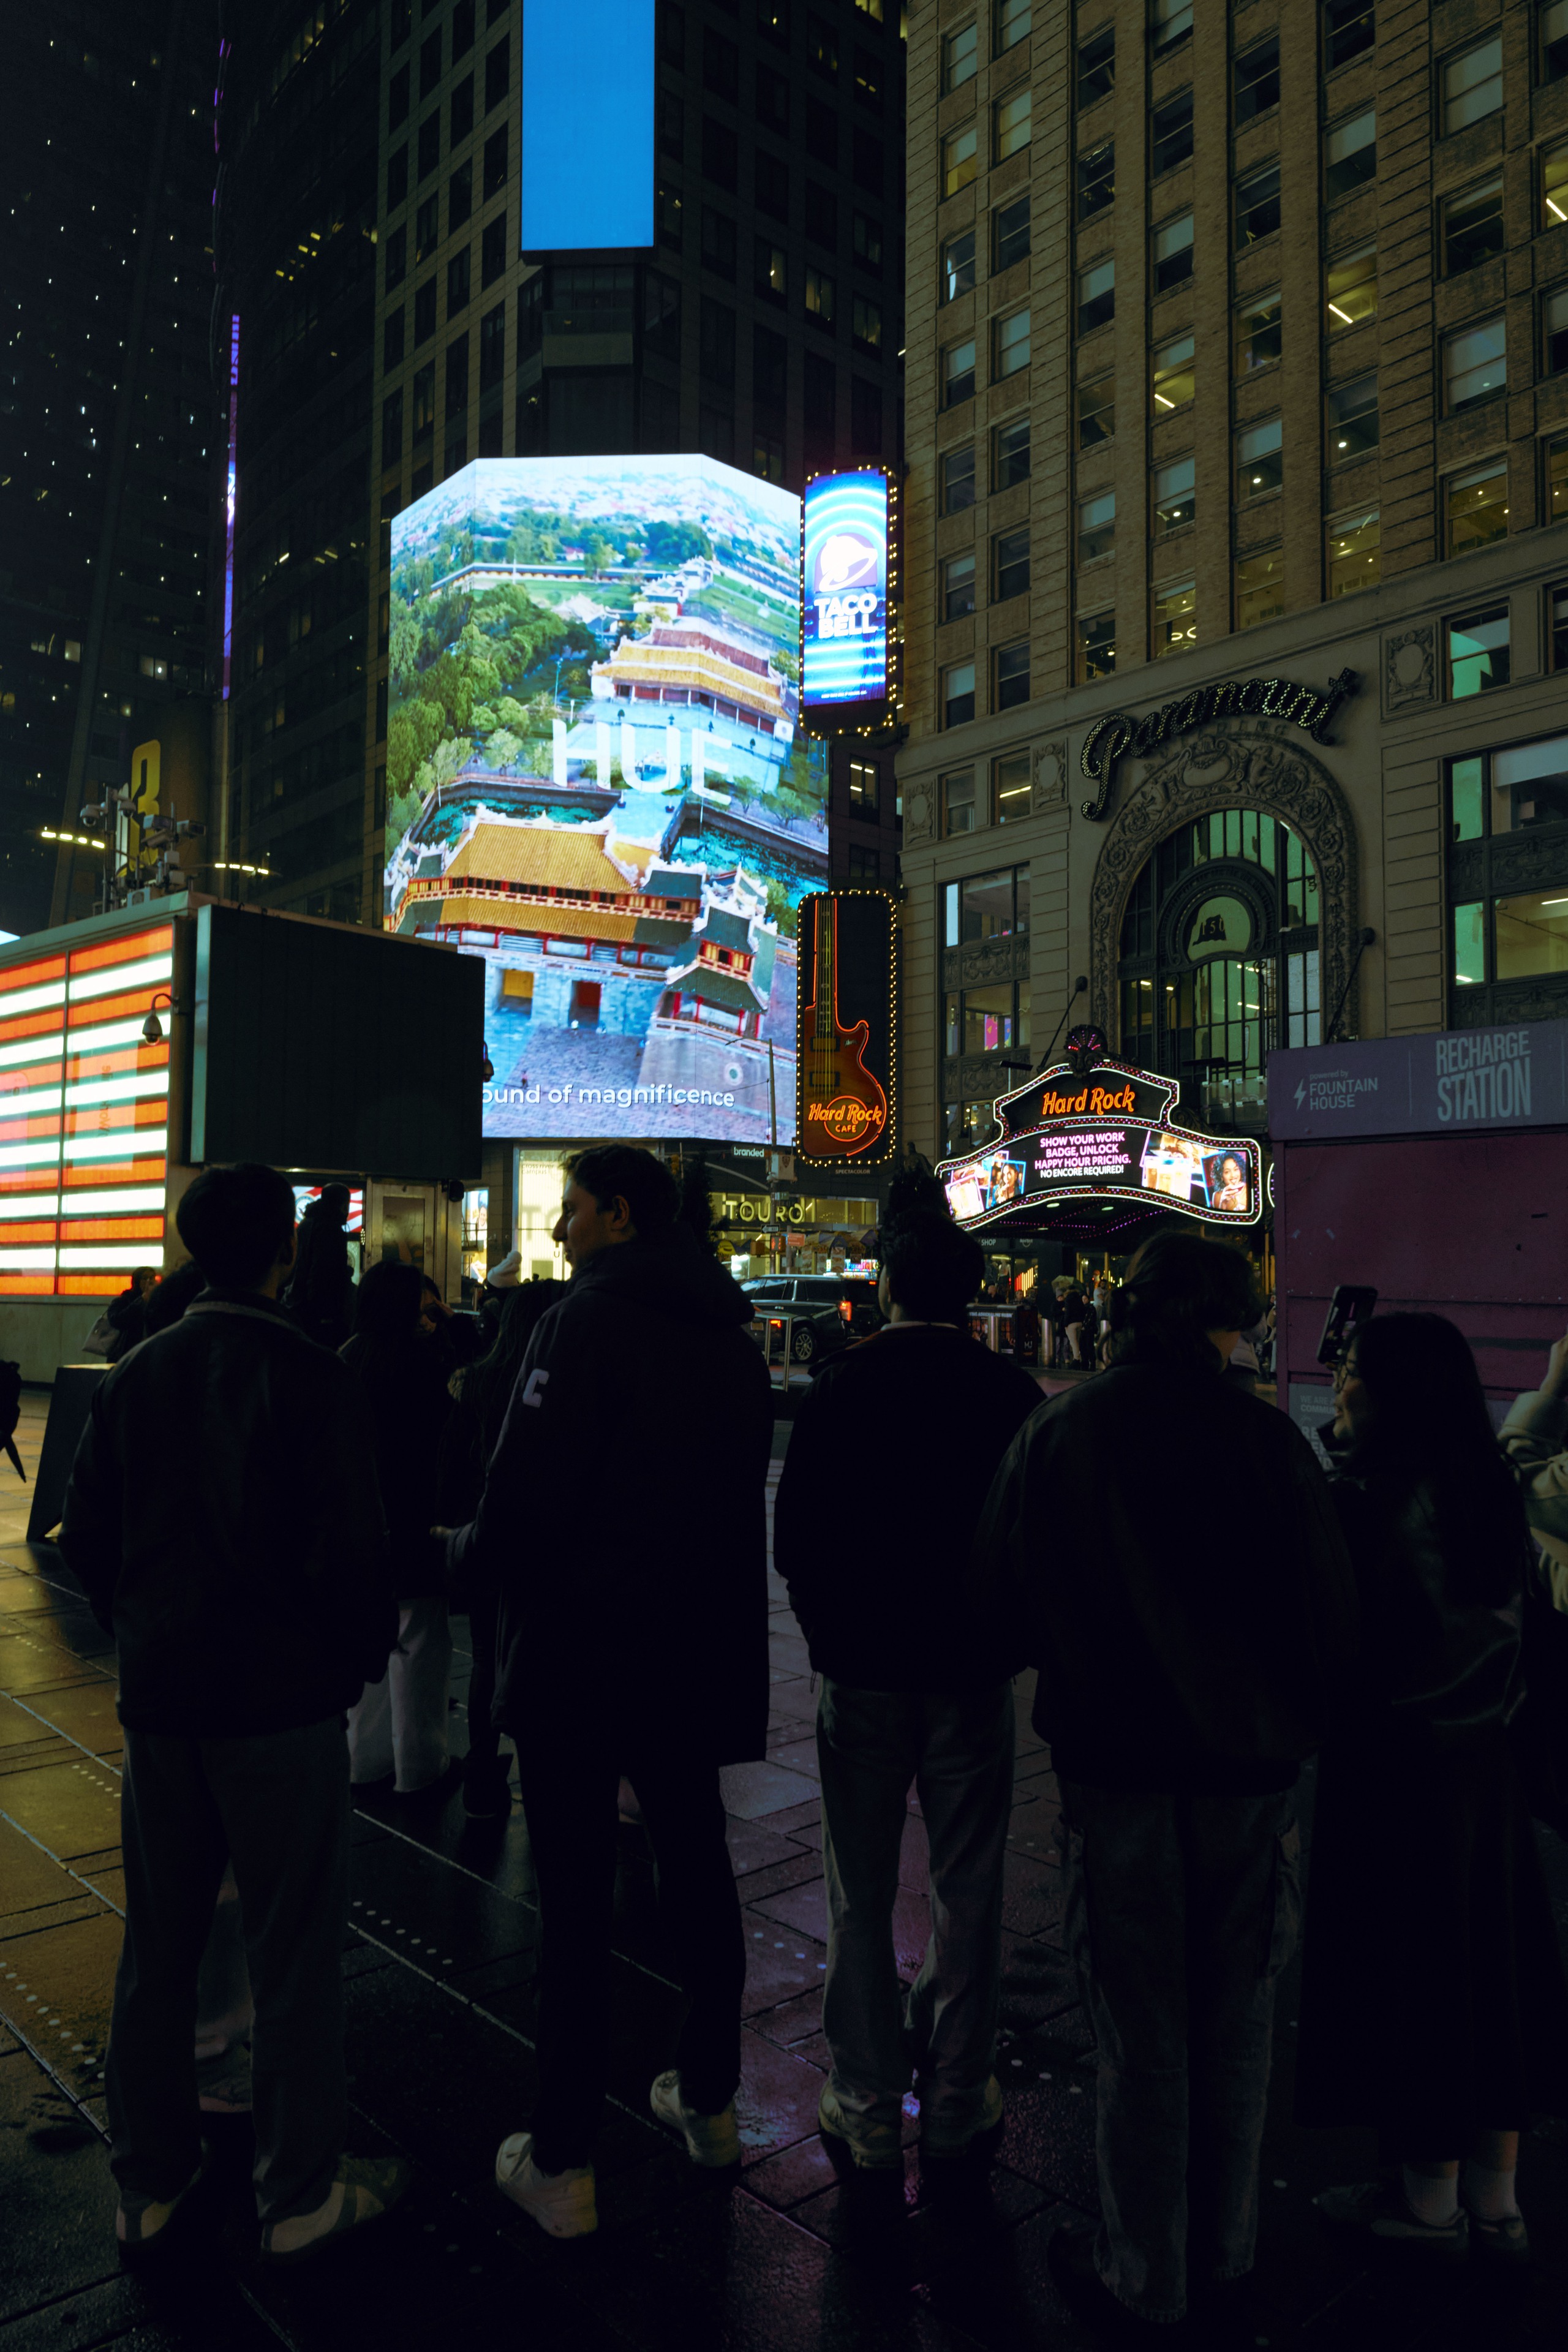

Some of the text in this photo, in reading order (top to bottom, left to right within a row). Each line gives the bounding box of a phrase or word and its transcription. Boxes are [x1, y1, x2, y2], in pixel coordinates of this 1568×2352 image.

[814, 593, 878, 619] TACO
[818, 613, 878, 639] BELL
[1081, 667, 1356, 821] Paramount
[552, 718, 732, 805] HUE
[1436, 1030, 1531, 1076] RECHARGE
[1310, 1069, 1349, 1080] powered by
[483, 1084, 735, 1108] ound of magnificence
[1310, 1077, 1378, 1096] FOUNTAIN
[1438, 1057, 1531, 1121] STATION
[1041, 1084, 1136, 1115] Hard Rock
[1310, 1094, 1355, 1110] HOUSE
[808, 1103, 883, 1125] Hard Rock
[835, 1125, 857, 1133] CAFE
[1040, 1131, 1125, 1147] SHOW YOUR WORK
[733, 1147, 764, 1158] branded
[1035, 1153, 1131, 1169] HAPPY HOUR PRICING.
[1046, 1144, 1119, 1158] BADGE, UNLOCK
[1040, 1164, 1125, 1178] NO ENCORE REQUIRED!
[725, 1200, 804, 1224] TOURO
[522, 1368, 550, 1408] C
[1313, 1396, 1329, 1405] ARE
